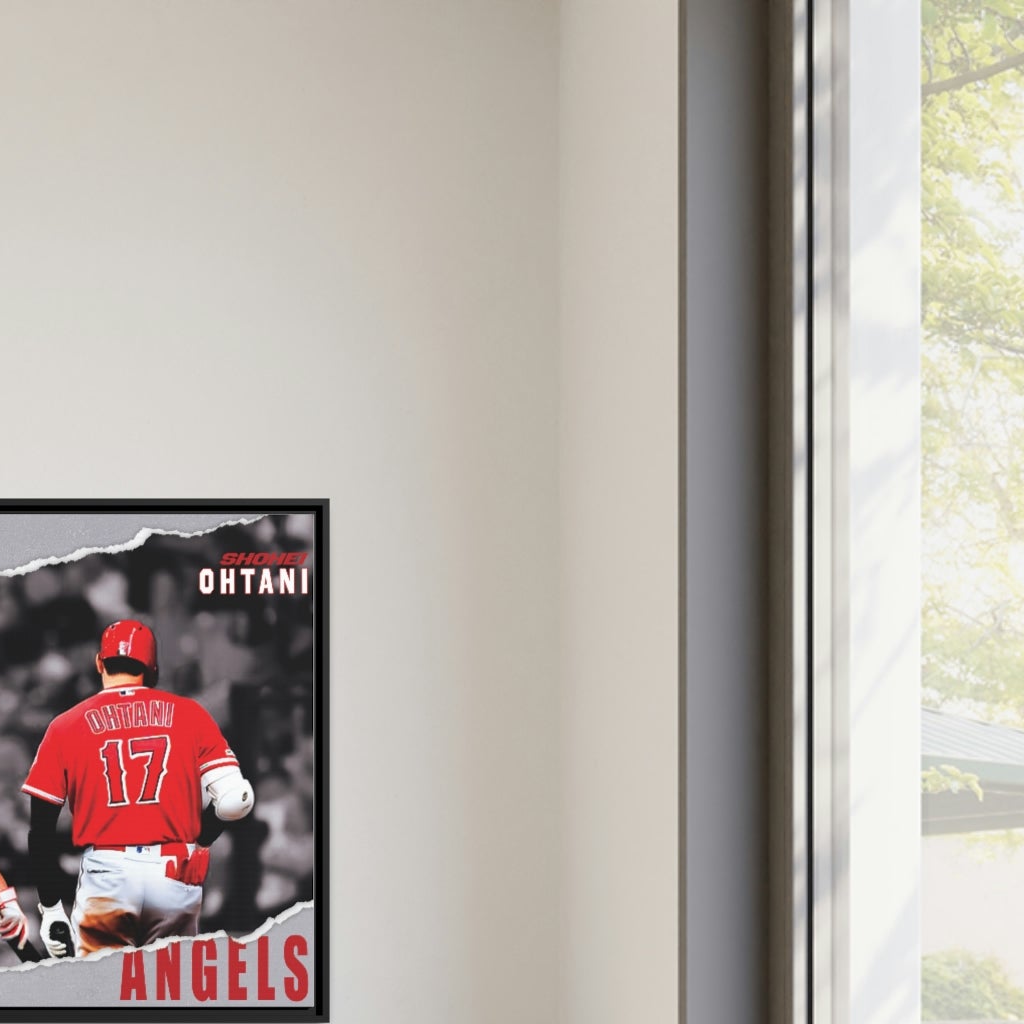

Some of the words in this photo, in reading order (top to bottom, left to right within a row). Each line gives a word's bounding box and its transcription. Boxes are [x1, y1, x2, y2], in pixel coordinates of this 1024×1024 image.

[219, 552, 308, 566] SHOHEI
[199, 568, 309, 595] OHTANI
[84, 700, 175, 735] OHTANI
[99, 734, 171, 808] 17
[120, 934, 309, 1002] ANGELS
